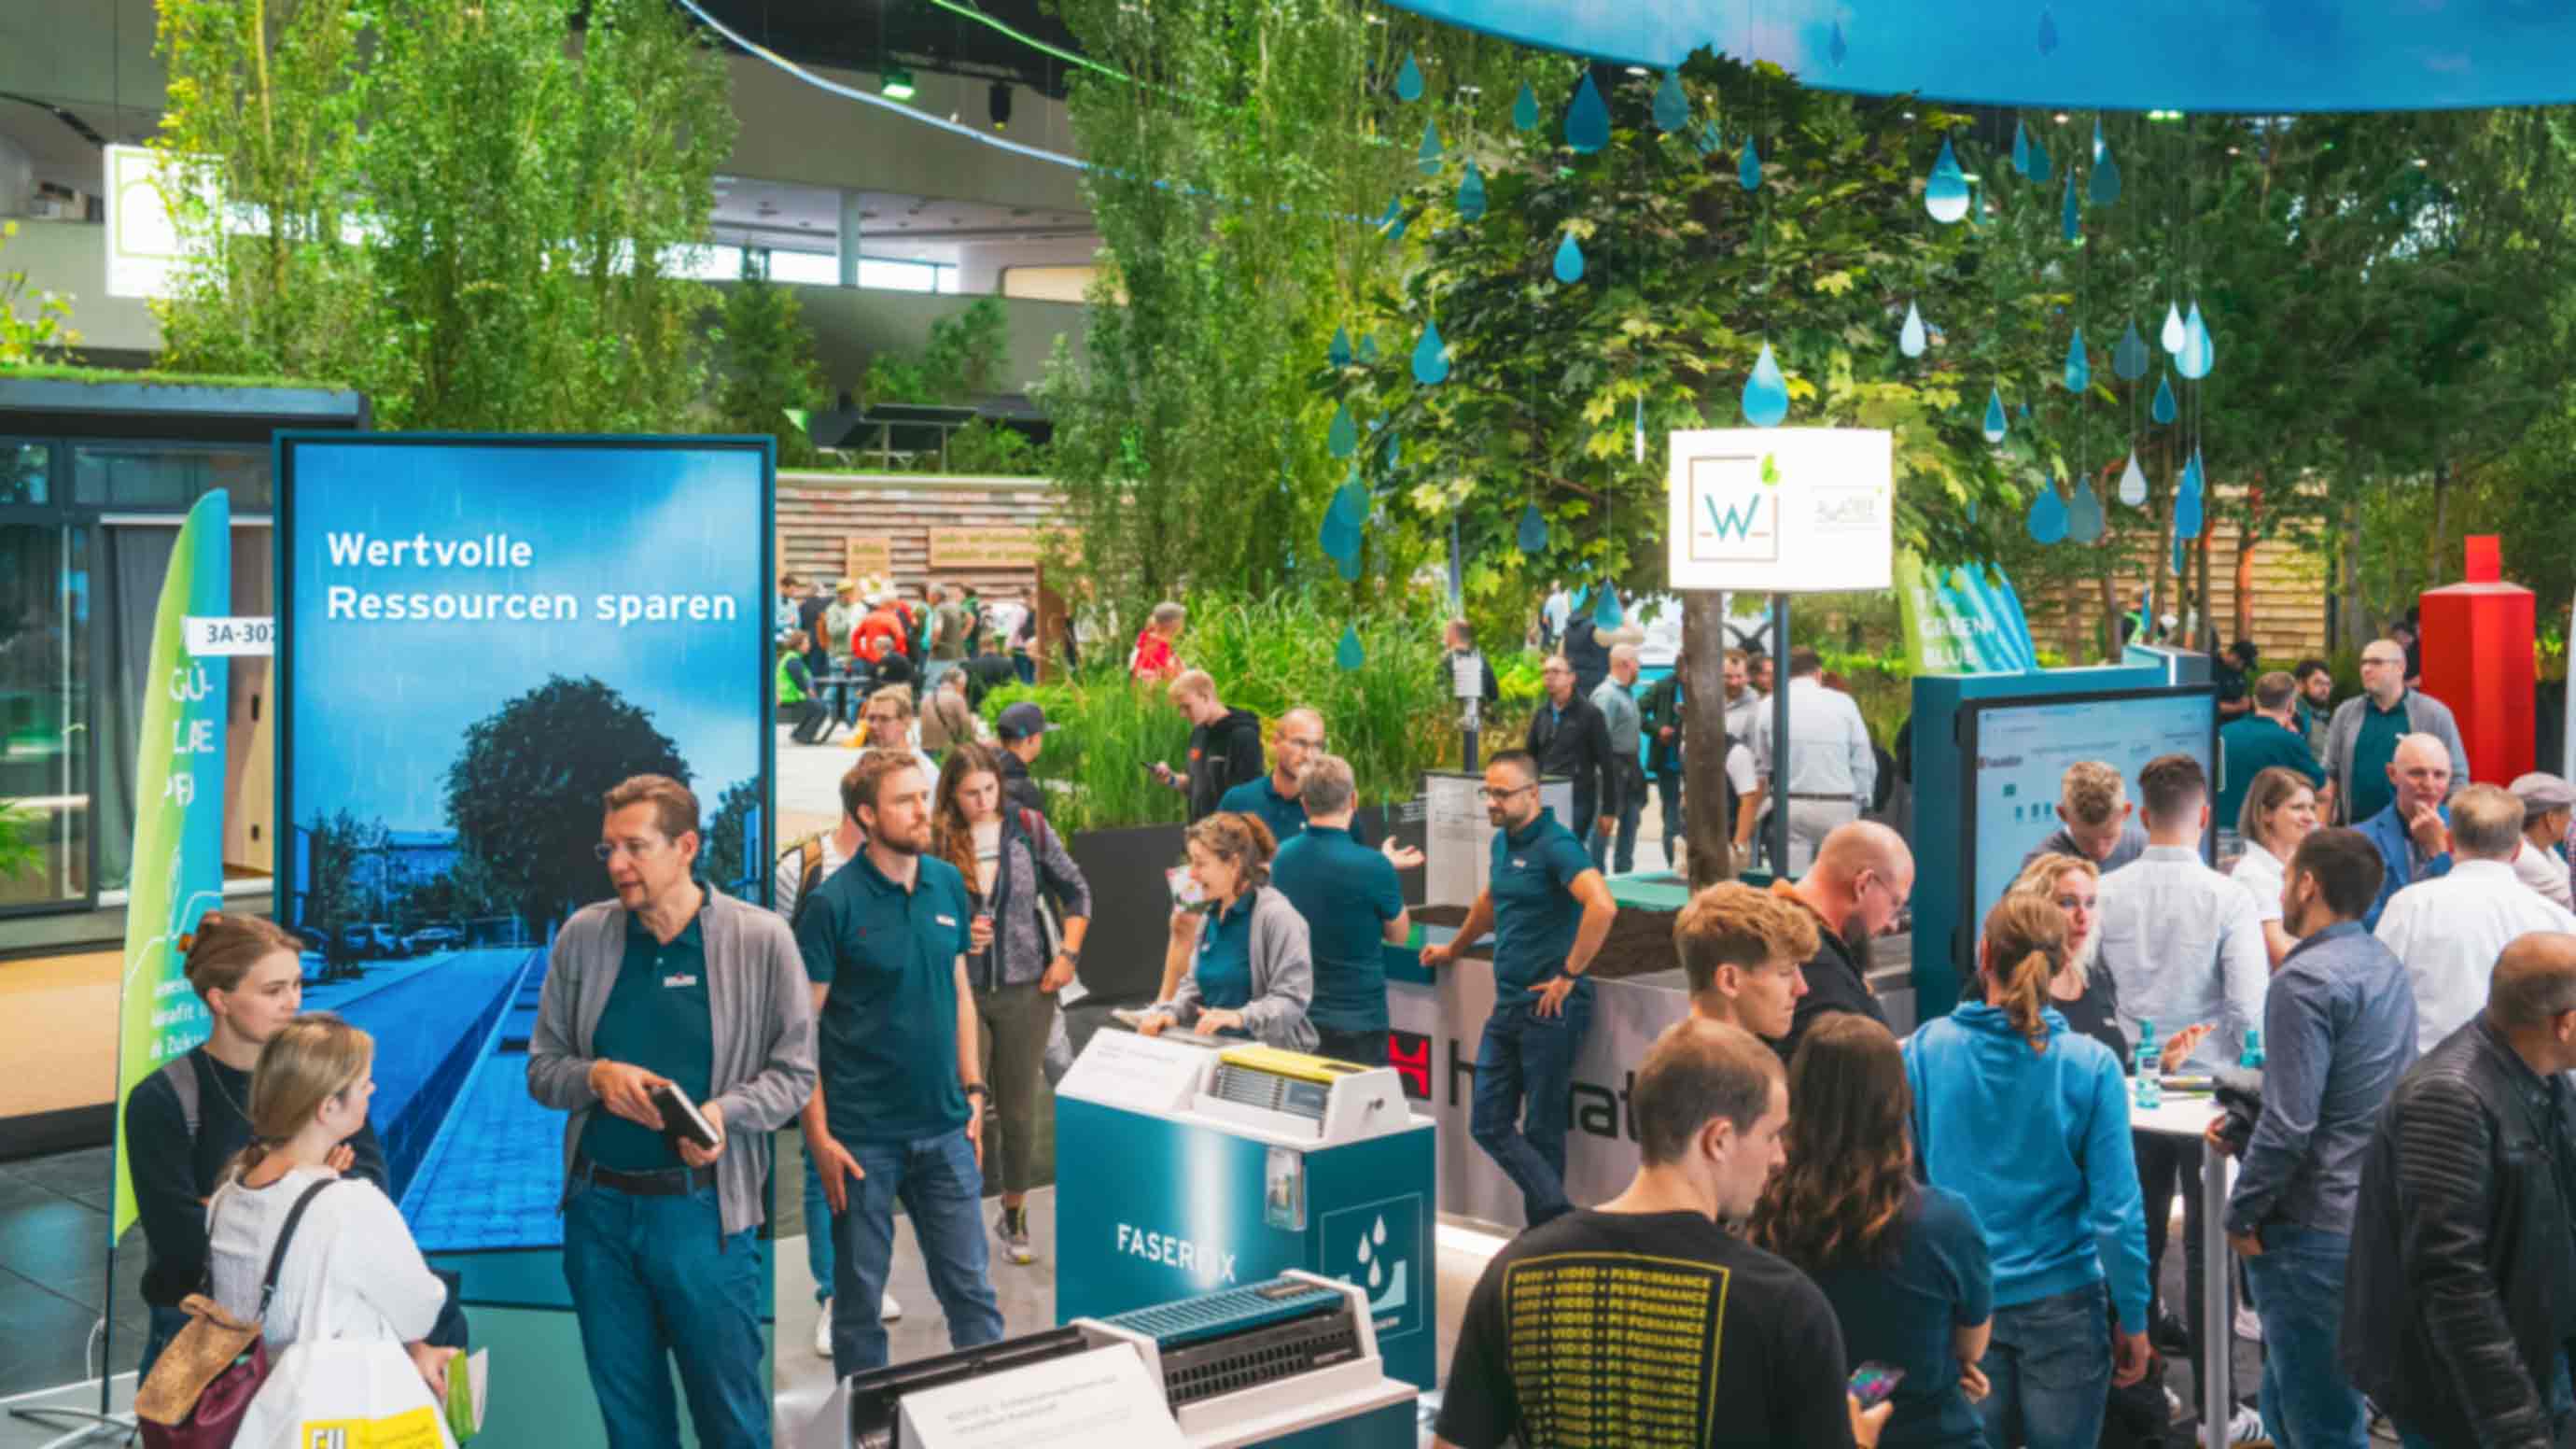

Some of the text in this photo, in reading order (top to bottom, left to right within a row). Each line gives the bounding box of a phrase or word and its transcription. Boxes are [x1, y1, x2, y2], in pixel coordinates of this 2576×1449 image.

[1704, 493, 1761, 542] W
[328, 533, 533, 567] Wertvolle
[328, 586, 736, 626] Ressourcen sparen
